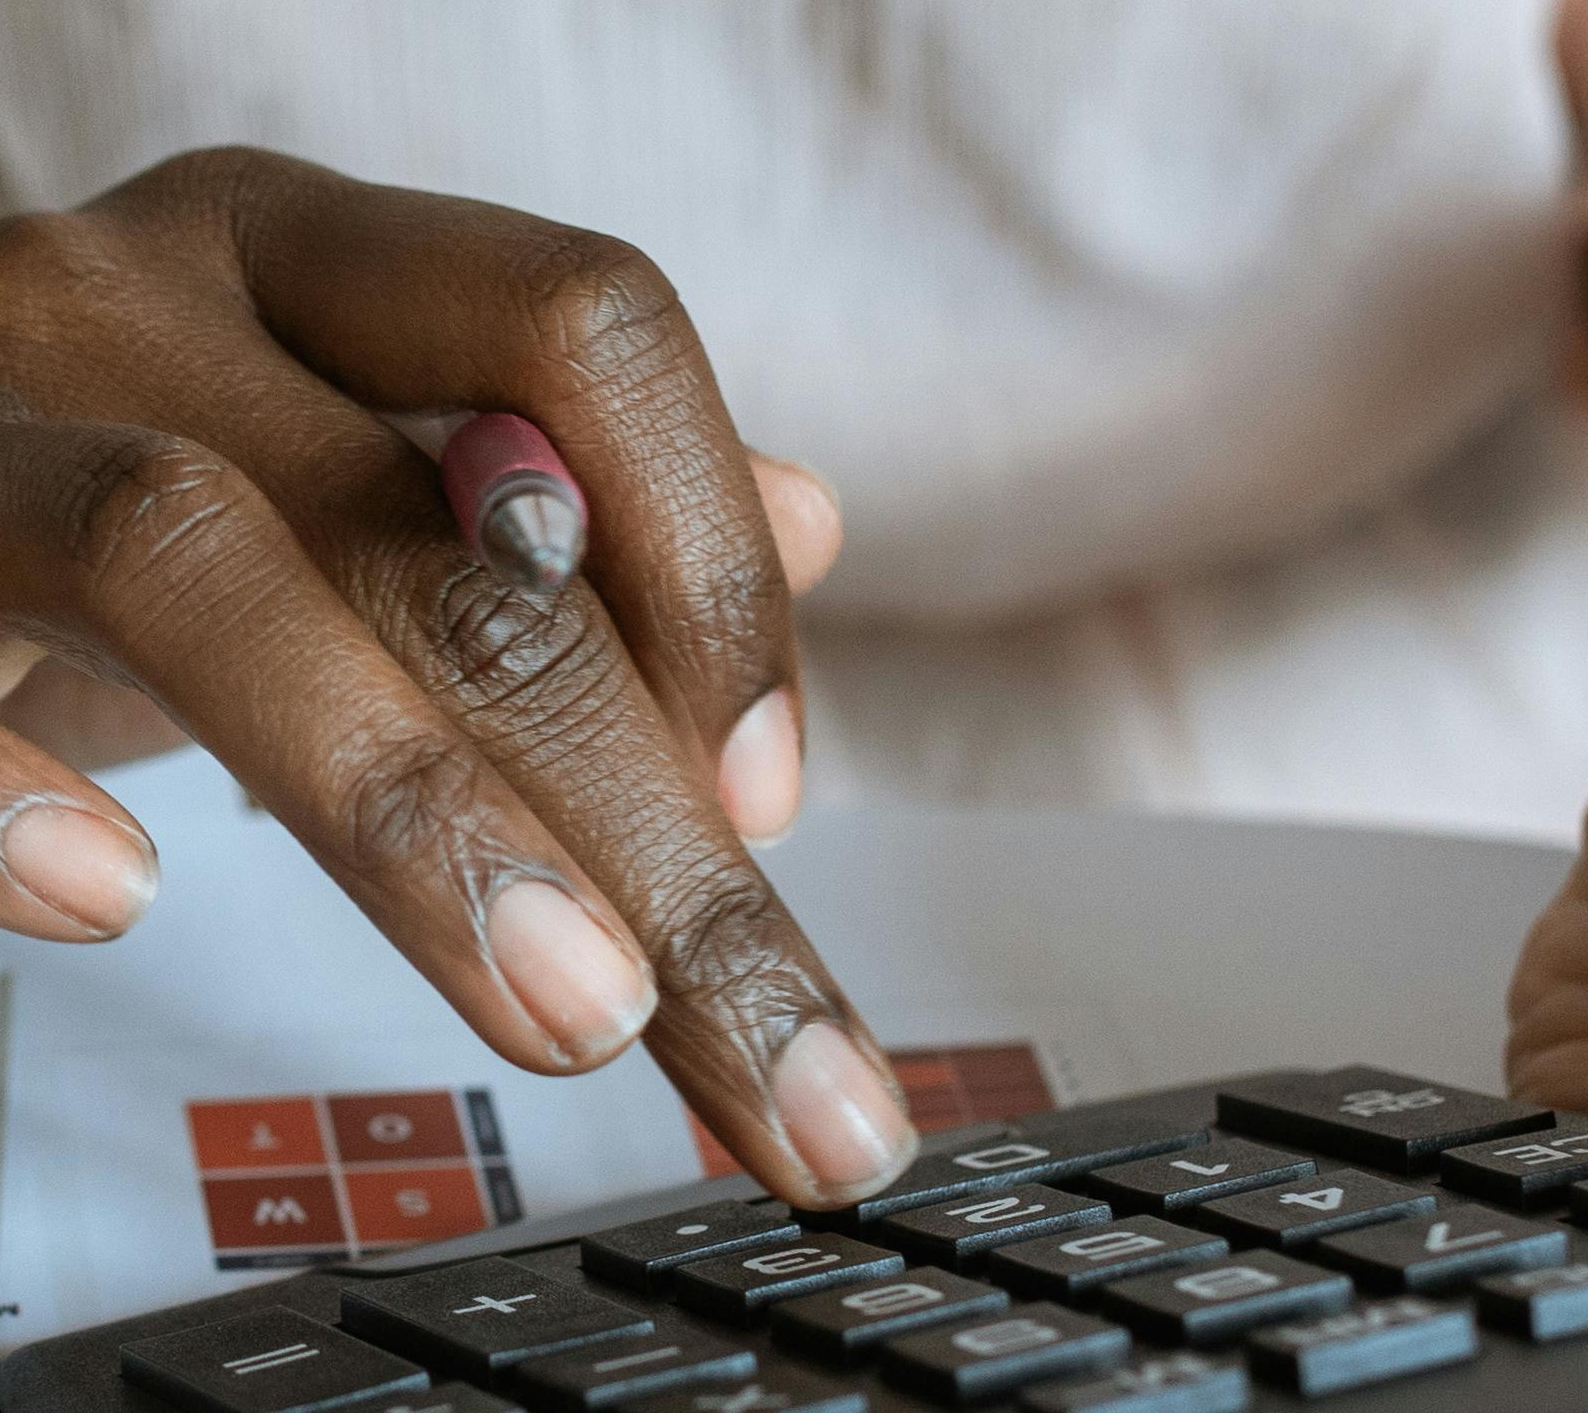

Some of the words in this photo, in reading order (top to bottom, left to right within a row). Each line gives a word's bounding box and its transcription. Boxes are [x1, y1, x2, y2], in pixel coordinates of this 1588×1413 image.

[367, 1112, 414, 1145] O
[951, 1143, 1051, 1171] 0
[1169, 1158, 1231, 1177] 1
[252, 1195, 309, 1226] W
[944, 1195, 1047, 1224] 2
[1277, 1186, 1344, 1211] 4
[1058, 1231, 1166, 1262] 5
[1422, 1221, 1504, 1253] 7
[741, 1247, 841, 1276] 3
